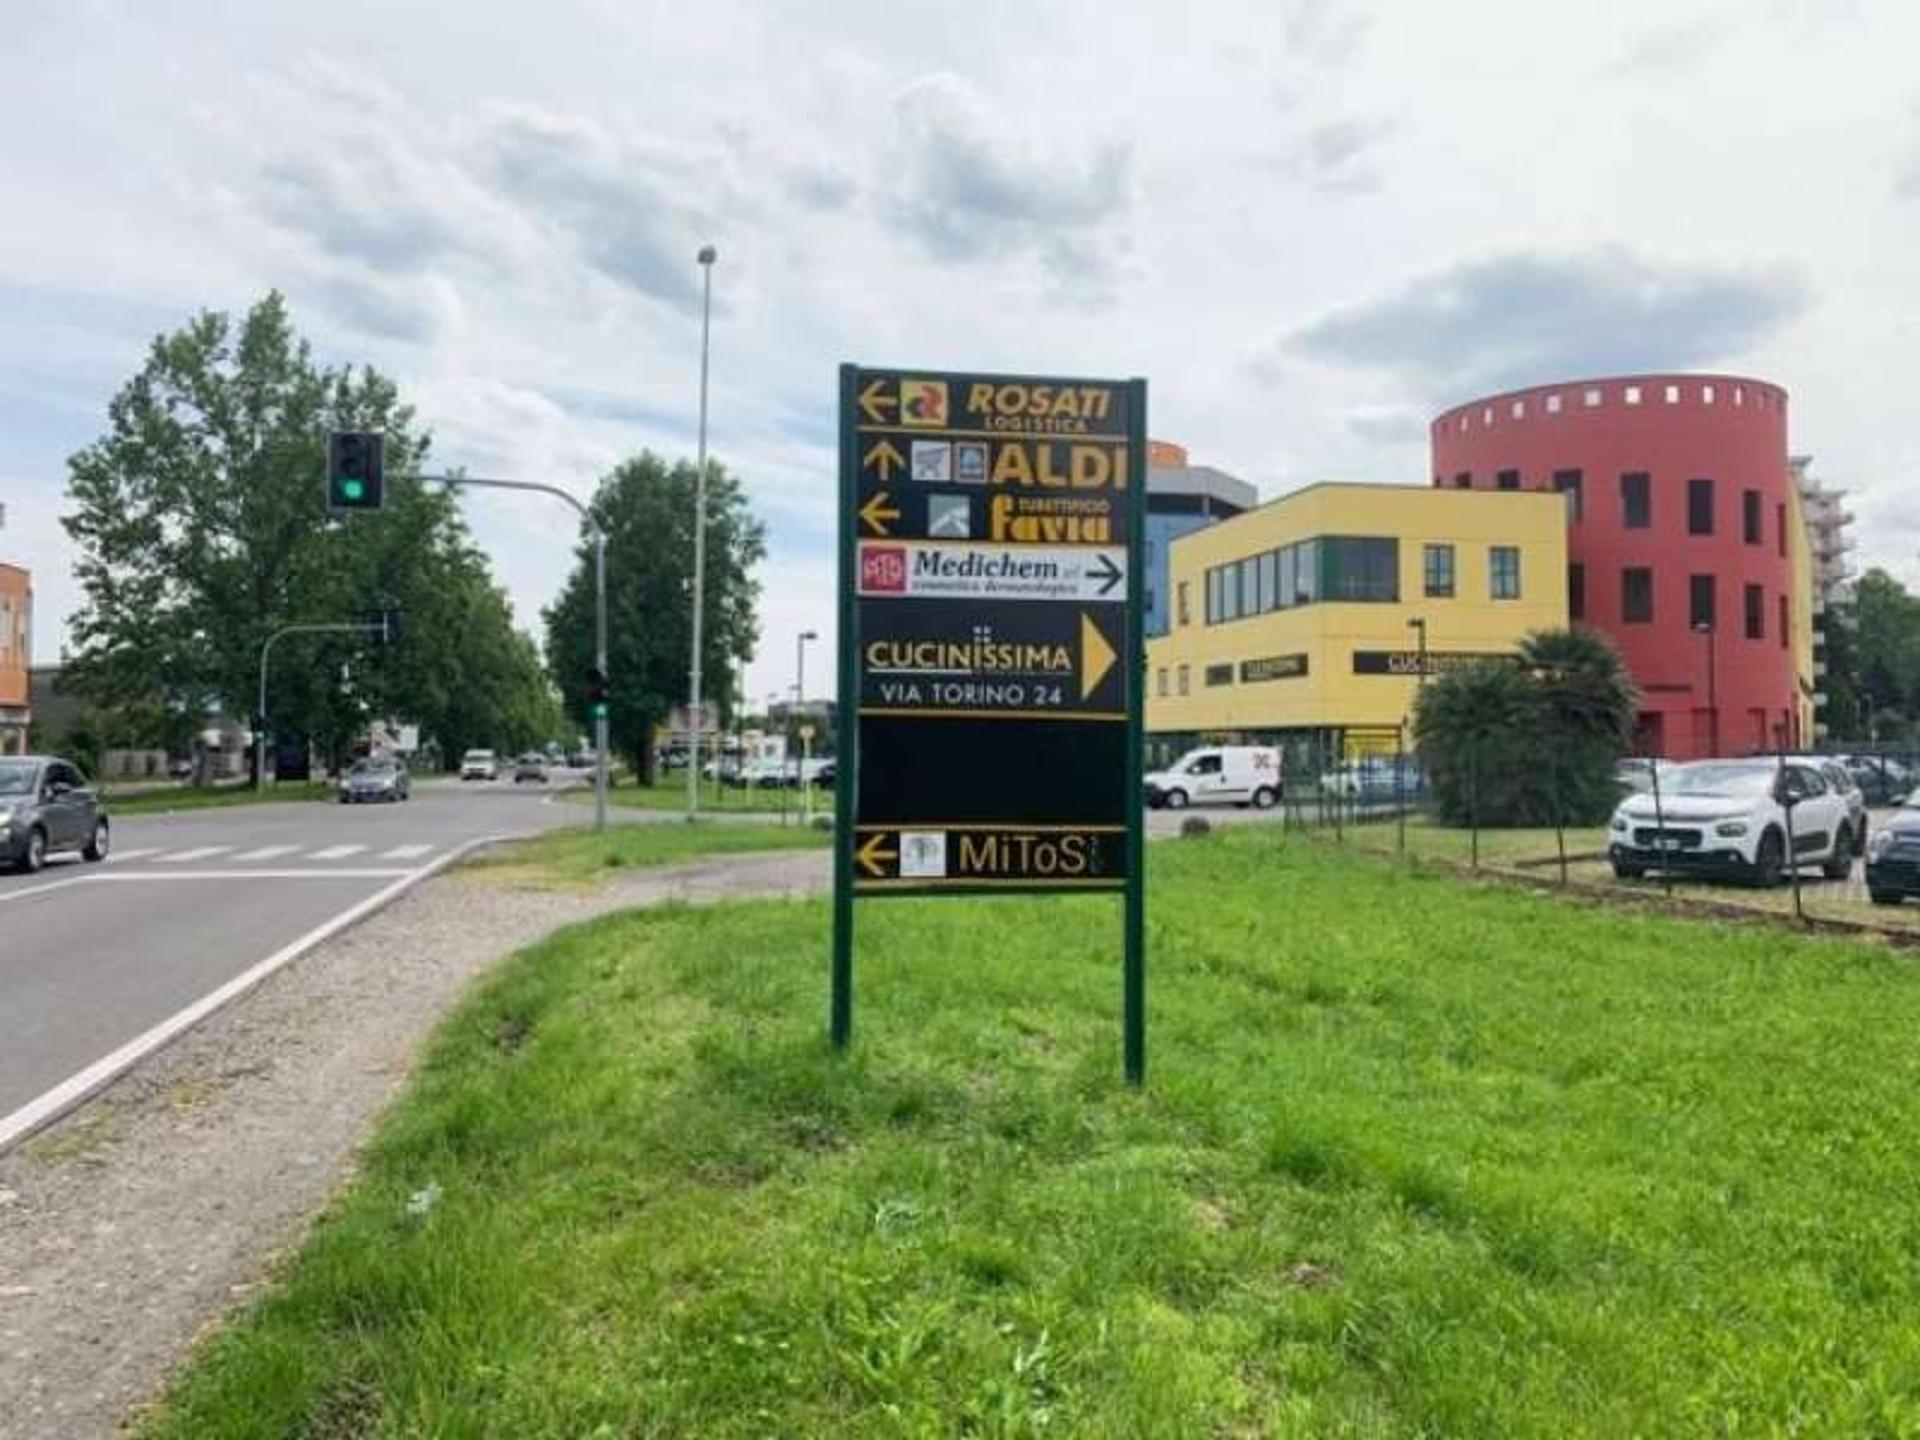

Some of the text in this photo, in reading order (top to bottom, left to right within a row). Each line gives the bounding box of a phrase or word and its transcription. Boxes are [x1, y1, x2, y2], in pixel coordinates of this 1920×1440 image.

[967, 383, 1111, 418] ROSATI
[984, 416, 1088, 432] LOGISTICA
[993, 443, 1127, 490] ALDI
[914, 551, 1058, 578] Medichem
[866, 638, 1073, 670] CUCINISSIMA
[880, 683, 1062, 704] VIA TORINO 24
